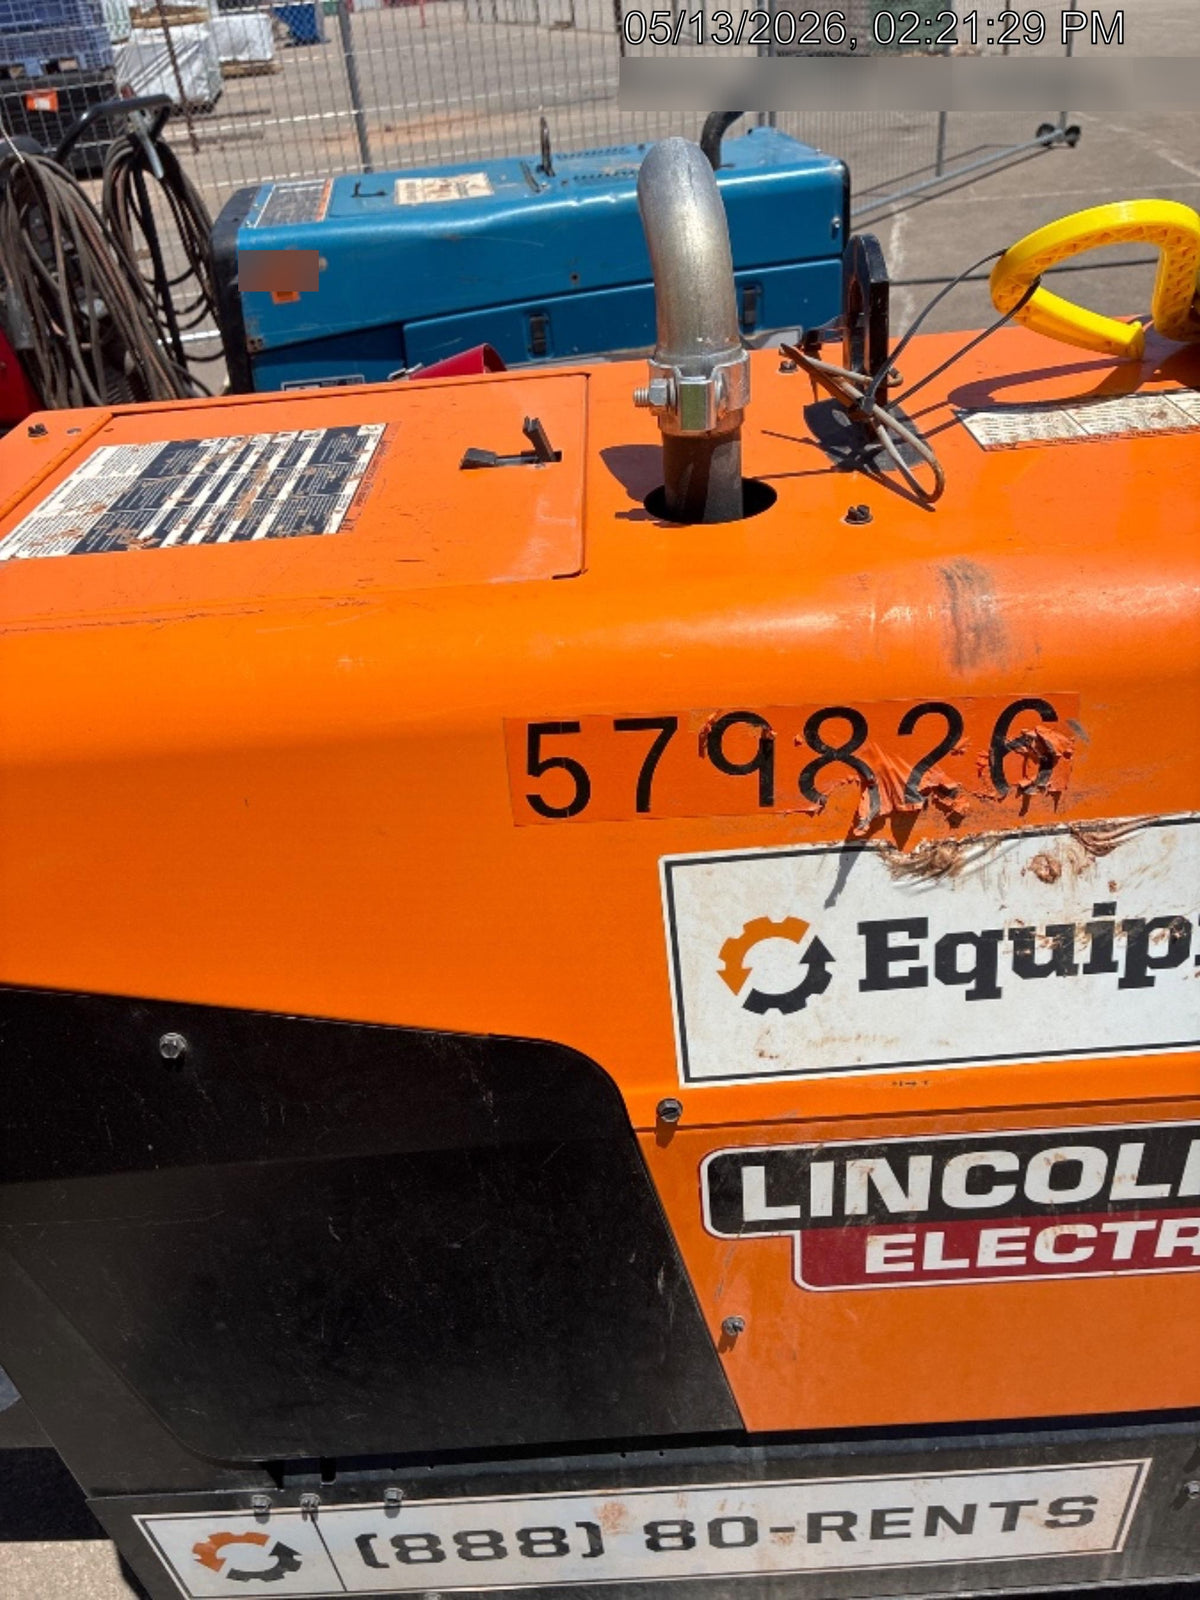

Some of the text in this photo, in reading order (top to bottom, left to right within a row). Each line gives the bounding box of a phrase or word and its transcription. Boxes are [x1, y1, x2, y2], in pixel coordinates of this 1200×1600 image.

[525, 698, 1060, 820] 579826
[857, 900, 1200, 1001] Equip
[864, 1217, 1200, 1275] ELECTR
[354, 1495, 1099, 1569] (888) 80-RENTS
